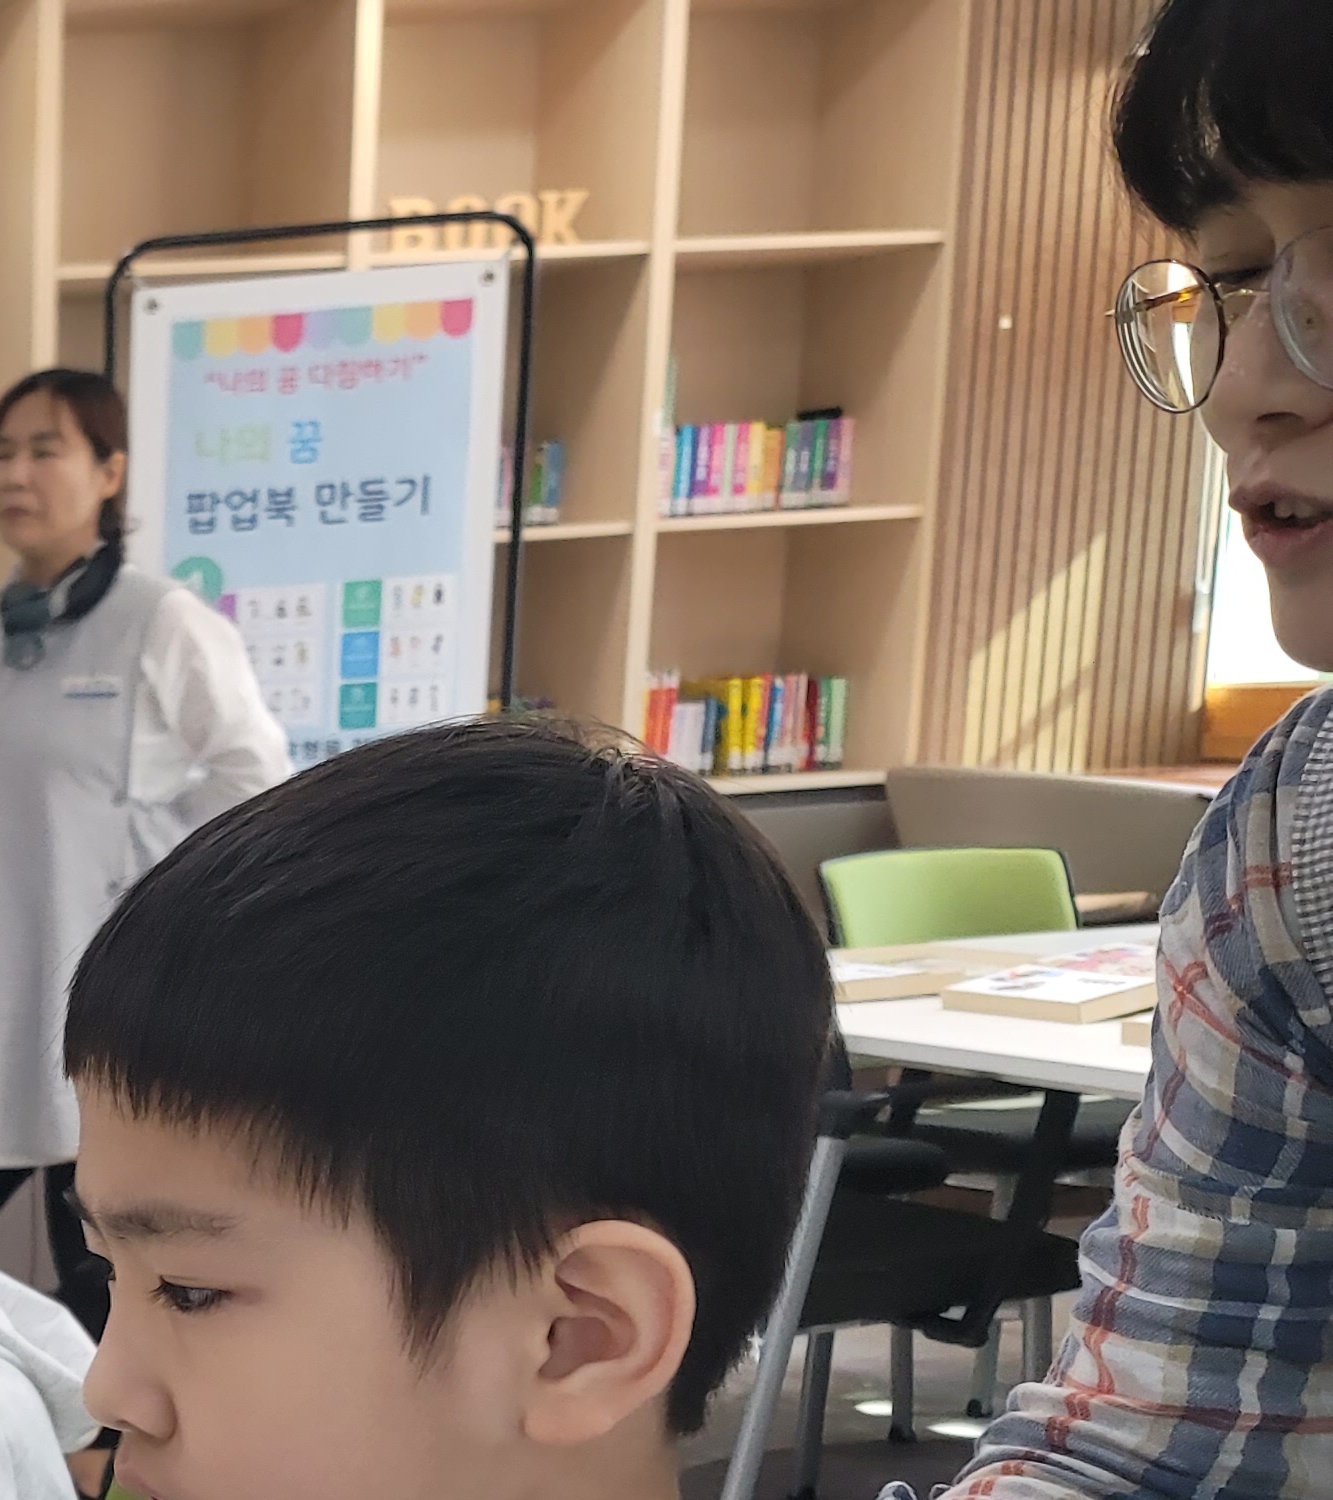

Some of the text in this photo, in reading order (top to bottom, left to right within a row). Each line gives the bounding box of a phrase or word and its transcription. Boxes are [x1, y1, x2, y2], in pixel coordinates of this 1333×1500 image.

[389, 190, 589, 250] BOOK
[289, 418, 323, 465] 꿈
[186, 474, 432, 535] 팝업북 만들기
